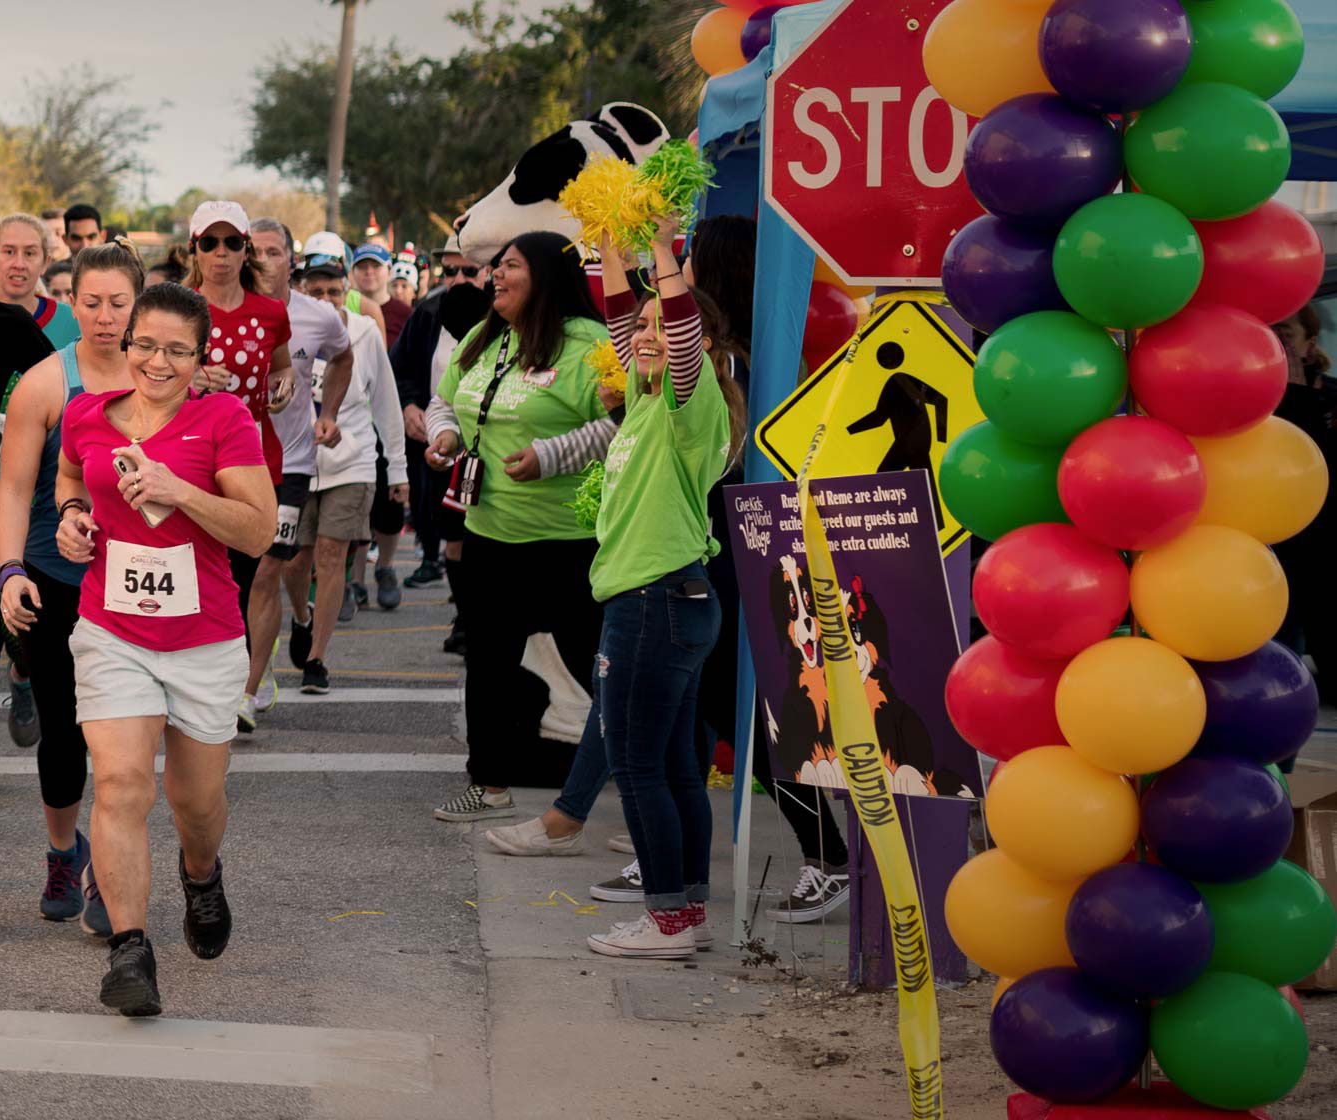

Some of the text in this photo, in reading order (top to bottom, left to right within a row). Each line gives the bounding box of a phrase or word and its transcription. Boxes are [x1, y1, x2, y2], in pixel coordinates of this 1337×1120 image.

[787, 85, 969, 189] STO
[780, 494, 800, 512] Rug
[827, 490, 853, 506] Reme
[854, 490, 871, 503] are
[872, 486, 907, 506] always
[276, 522, 297, 540] 81
[752, 511, 773, 527] World
[779, 516, 804, 531] excite
[845, 517, 862, 528] our
[864, 511, 896, 531] guests
[898, 507, 919, 525] and
[739, 521, 771, 556] Village
[792, 538, 806, 553] sha
[841, 536, 867, 551] extra
[868, 532, 910, 551] cuddles!
[130, 556, 168, 568] CHALLENGE
[124, 568, 175, 596] 544
[813, 577, 853, 662] CAUTION
[841, 742, 895, 827] CAUTION
[889, 903, 930, 993] CAUTION
